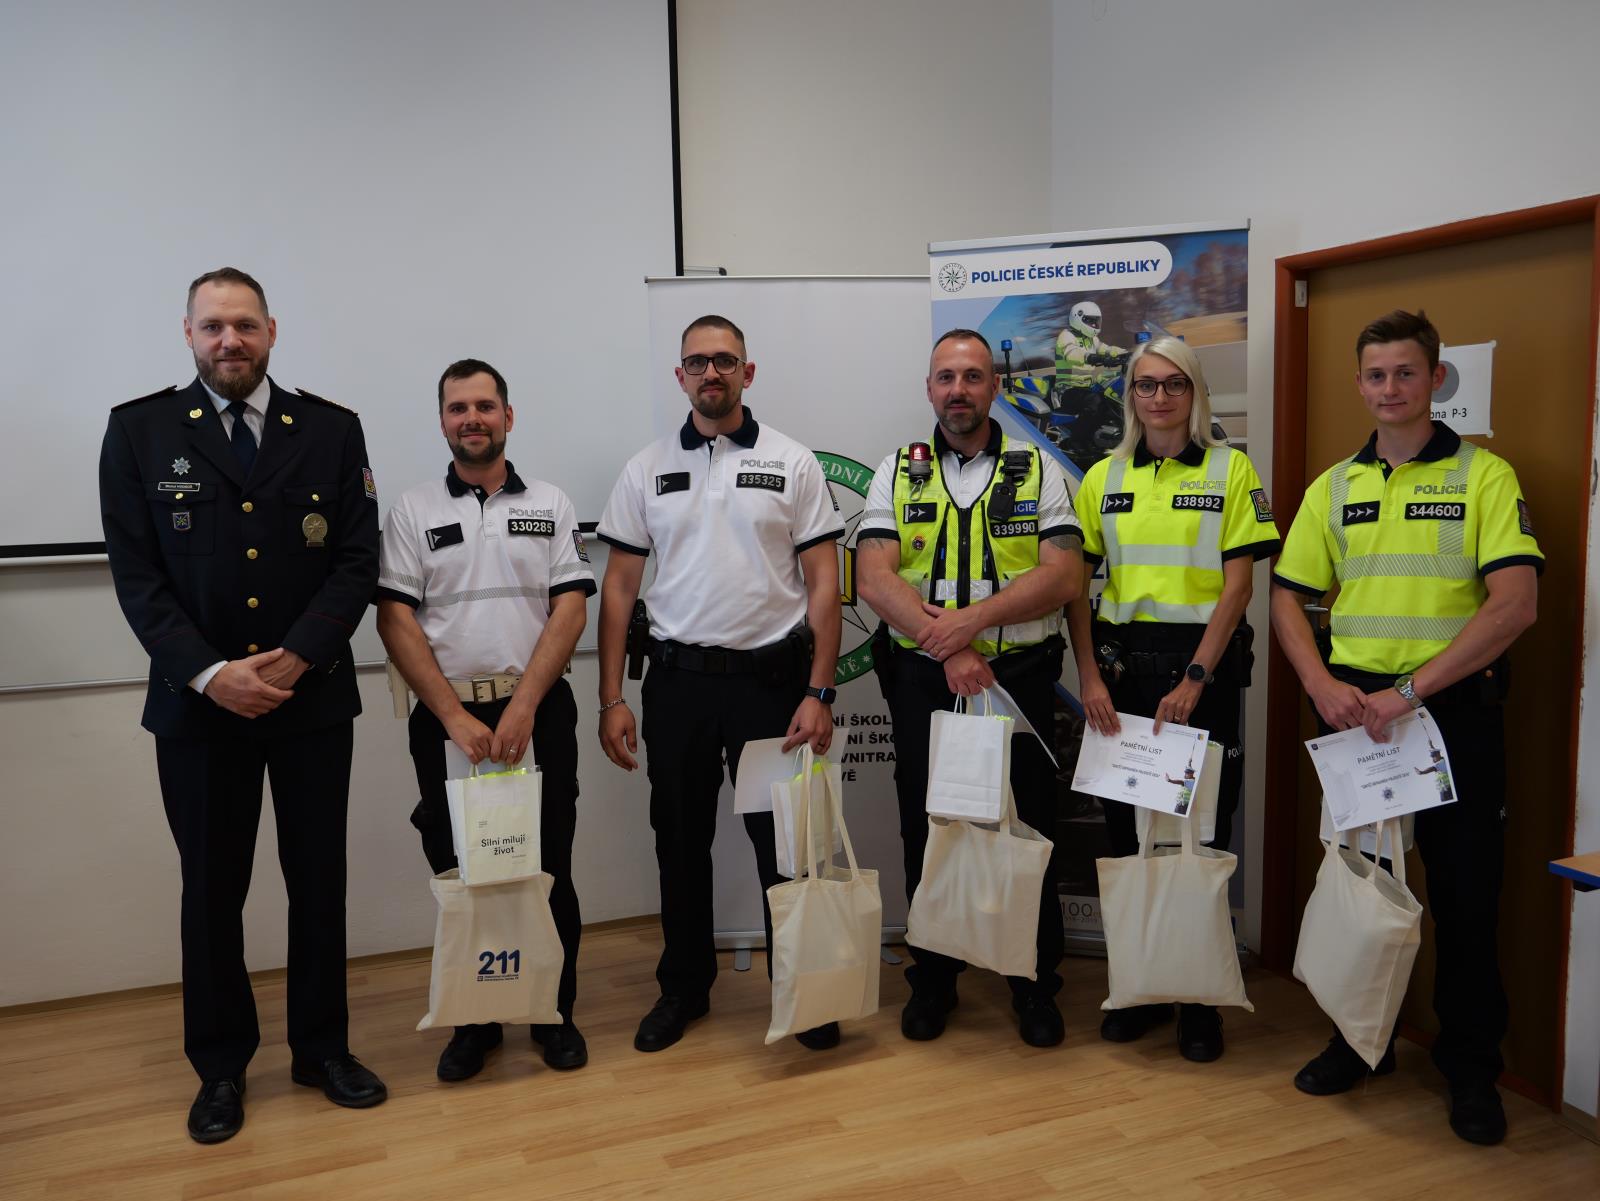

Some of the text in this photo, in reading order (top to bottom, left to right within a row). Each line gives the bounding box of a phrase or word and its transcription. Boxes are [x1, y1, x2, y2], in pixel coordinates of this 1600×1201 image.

[971, 268, 1025, 284] POLICIE
[1028, 262, 1073, 280] ČESKÉ
[1077, 258, 1161, 277] REPUBLIKY
[1452, 407, 1467, 419] P-3
[740, 460, 785, 470] POLICIE
[740, 474, 782, 488] 335325
[1179, 480, 1226, 491] POLICIE
[1413, 483, 1467, 495] POLICIE
[1175, 496, 1220, 509] 338992
[509, 508, 554, 519] POLICIE
[1409, 505, 1461, 517] 344600
[511, 520, 553, 533] 330285
[994, 522, 1035, 536] 339990
[1149, 747, 1163, 755] LIST
[1386, 746, 1400, 756] LIST
[494, 846, 514, 856] život
[478, 949, 520, 975] 211
